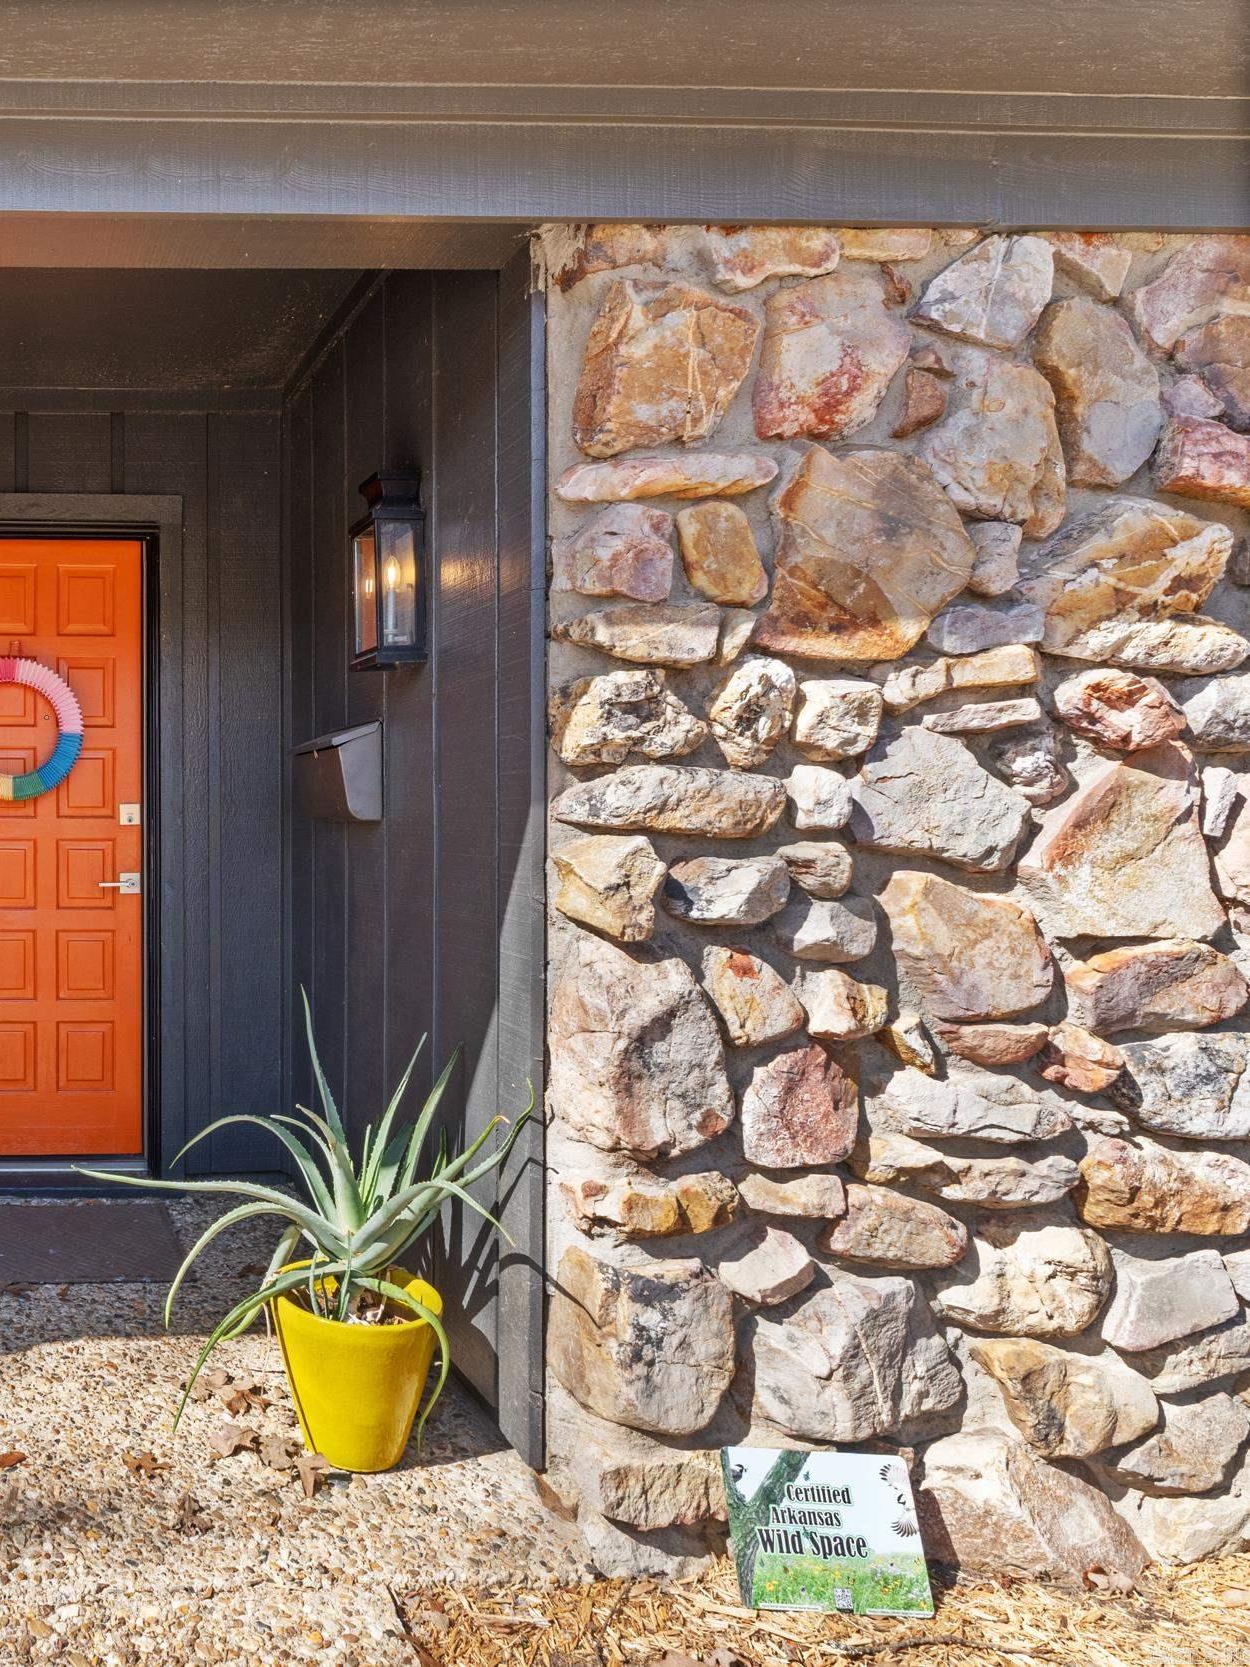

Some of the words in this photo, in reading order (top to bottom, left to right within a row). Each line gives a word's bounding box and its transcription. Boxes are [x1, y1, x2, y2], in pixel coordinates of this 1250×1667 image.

[786, 1484, 852, 1504] Certified
[771, 1506, 841, 1527] Arkansas
[758, 1528, 804, 1555] Wild
[810, 1531, 868, 1560] Space
